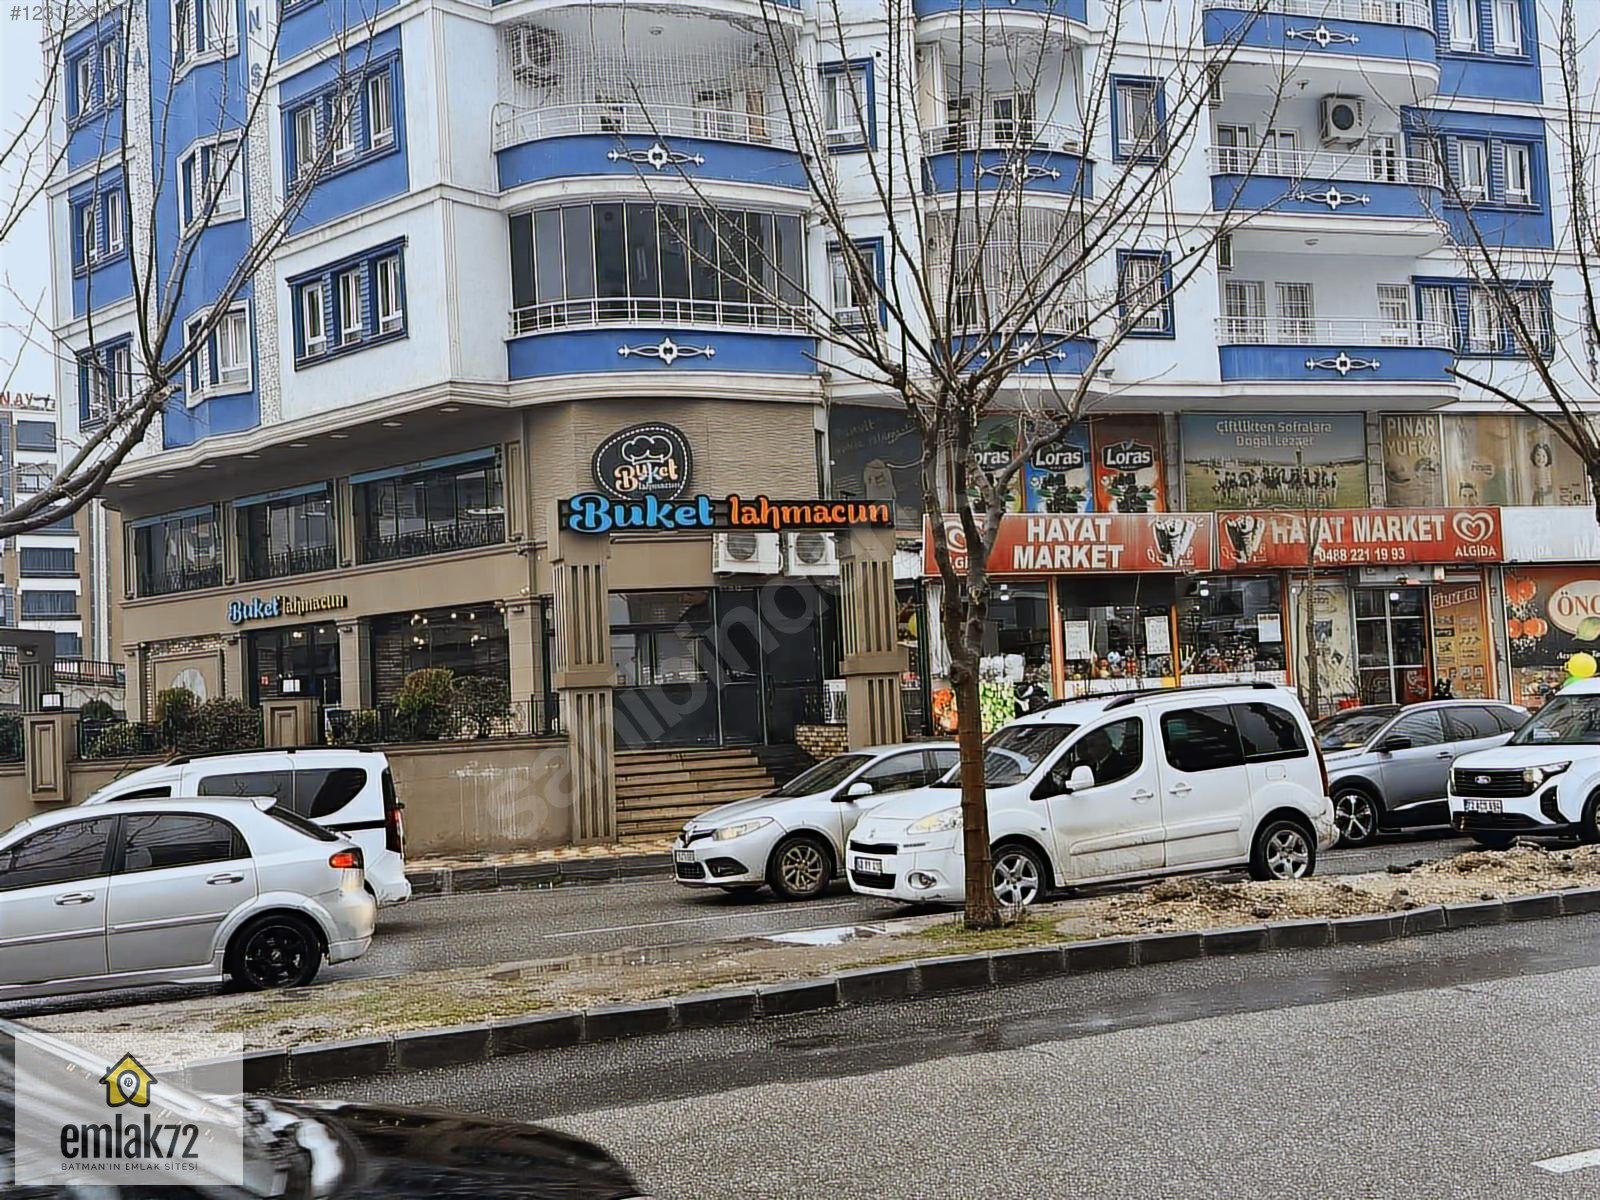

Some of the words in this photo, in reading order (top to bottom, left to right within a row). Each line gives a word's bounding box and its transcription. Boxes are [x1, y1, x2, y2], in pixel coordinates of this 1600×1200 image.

[1277, 420, 1333, 433] Sofralara
[1386, 416, 1435, 437] PINAR
[974, 450, 1010, 465] oras
[1035, 448, 1082, 466] Loras
[1106, 448, 1151, 466] Loras
[614, 458, 679, 492] Buket
[568, 494, 715, 533] Buket
[729, 496, 890, 529] lahmacun
[1027, 518, 1112, 542] HAYAT
[1271, 516, 1345, 544] HAYAT
[1352, 515, 1445, 543] MARKET
[1013, 544, 1125, 569] MARKET
[1319, 548, 1347, 562] 0488
[1350, 548, 1371, 561] 221
[1374, 547, 1388, 561] 19
[1391, 547, 1406, 561] 93
[228, 595, 279, 623] Buket
[281, 595, 348, 616] lahmacun
